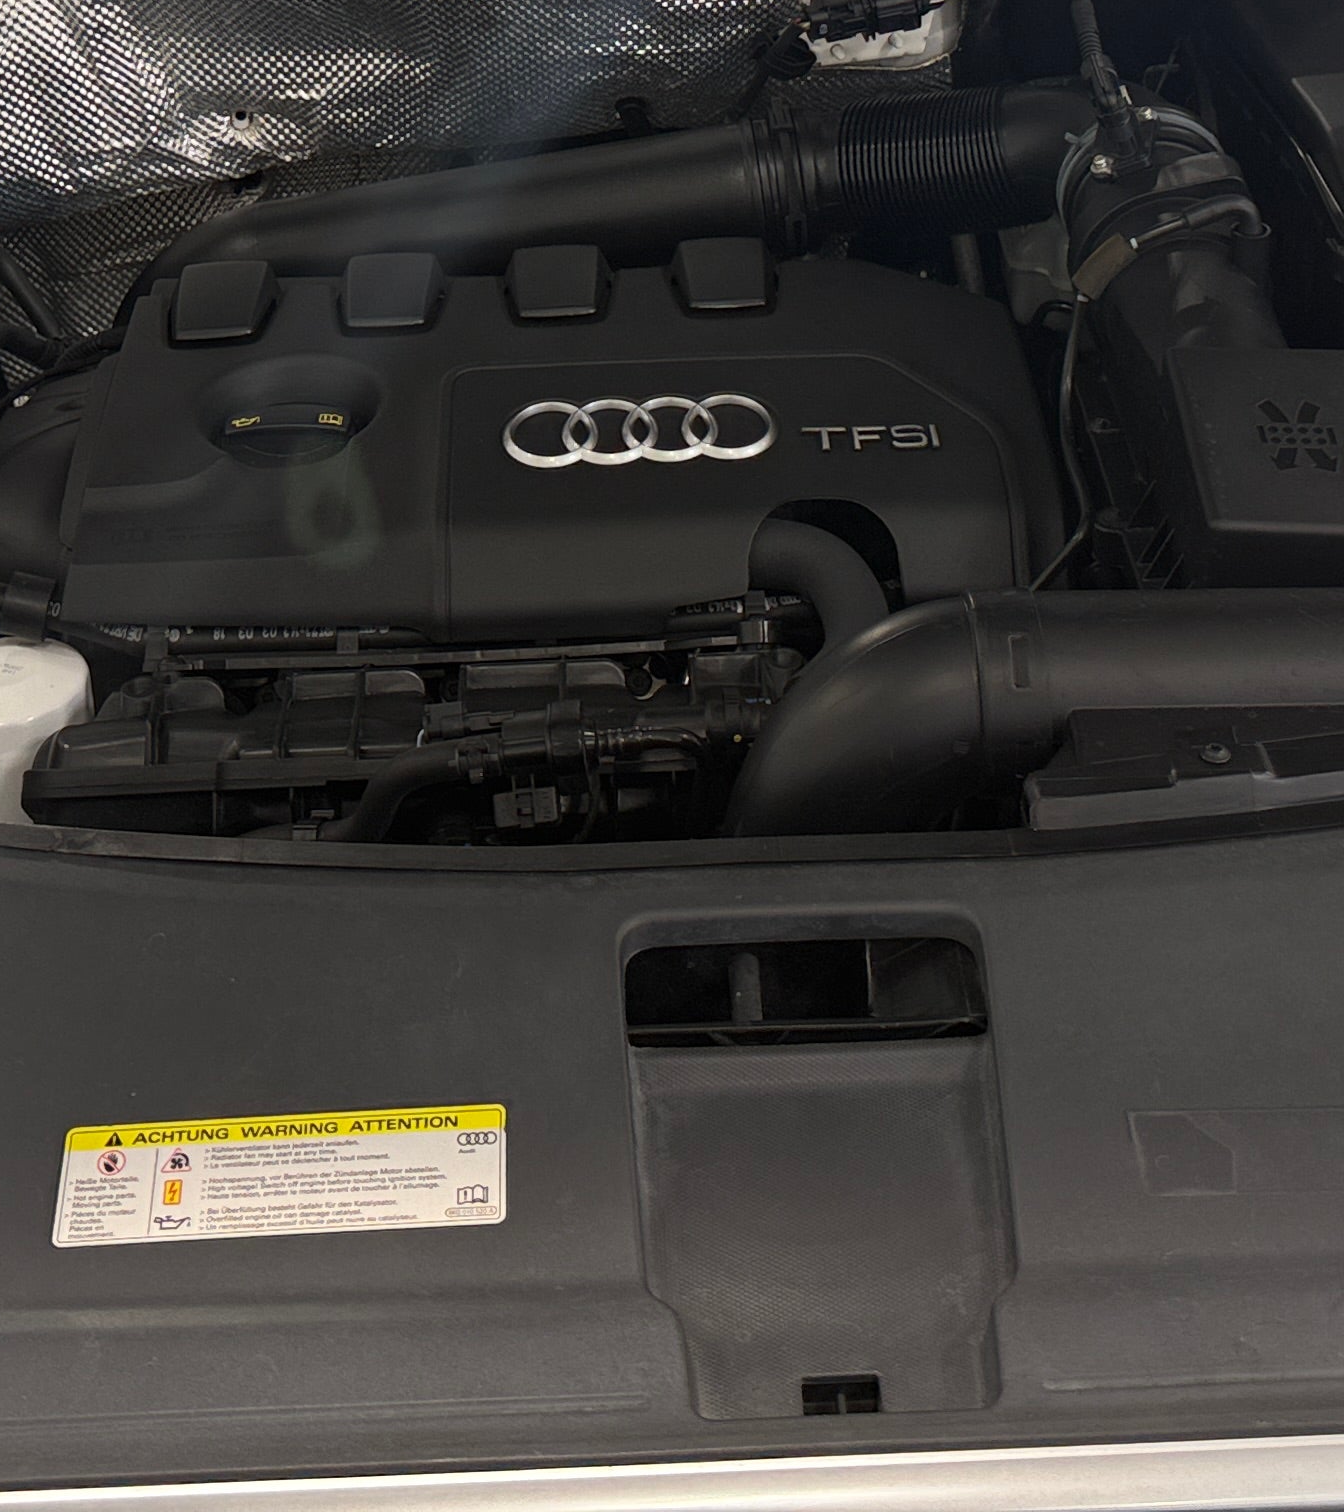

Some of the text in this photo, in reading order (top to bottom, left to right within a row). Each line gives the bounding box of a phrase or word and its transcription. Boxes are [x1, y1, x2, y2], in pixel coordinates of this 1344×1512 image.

[801, 424, 942, 453] TFSI
[132, 1115, 458, 1145] ACHTUNG WARNING ATTENTION
